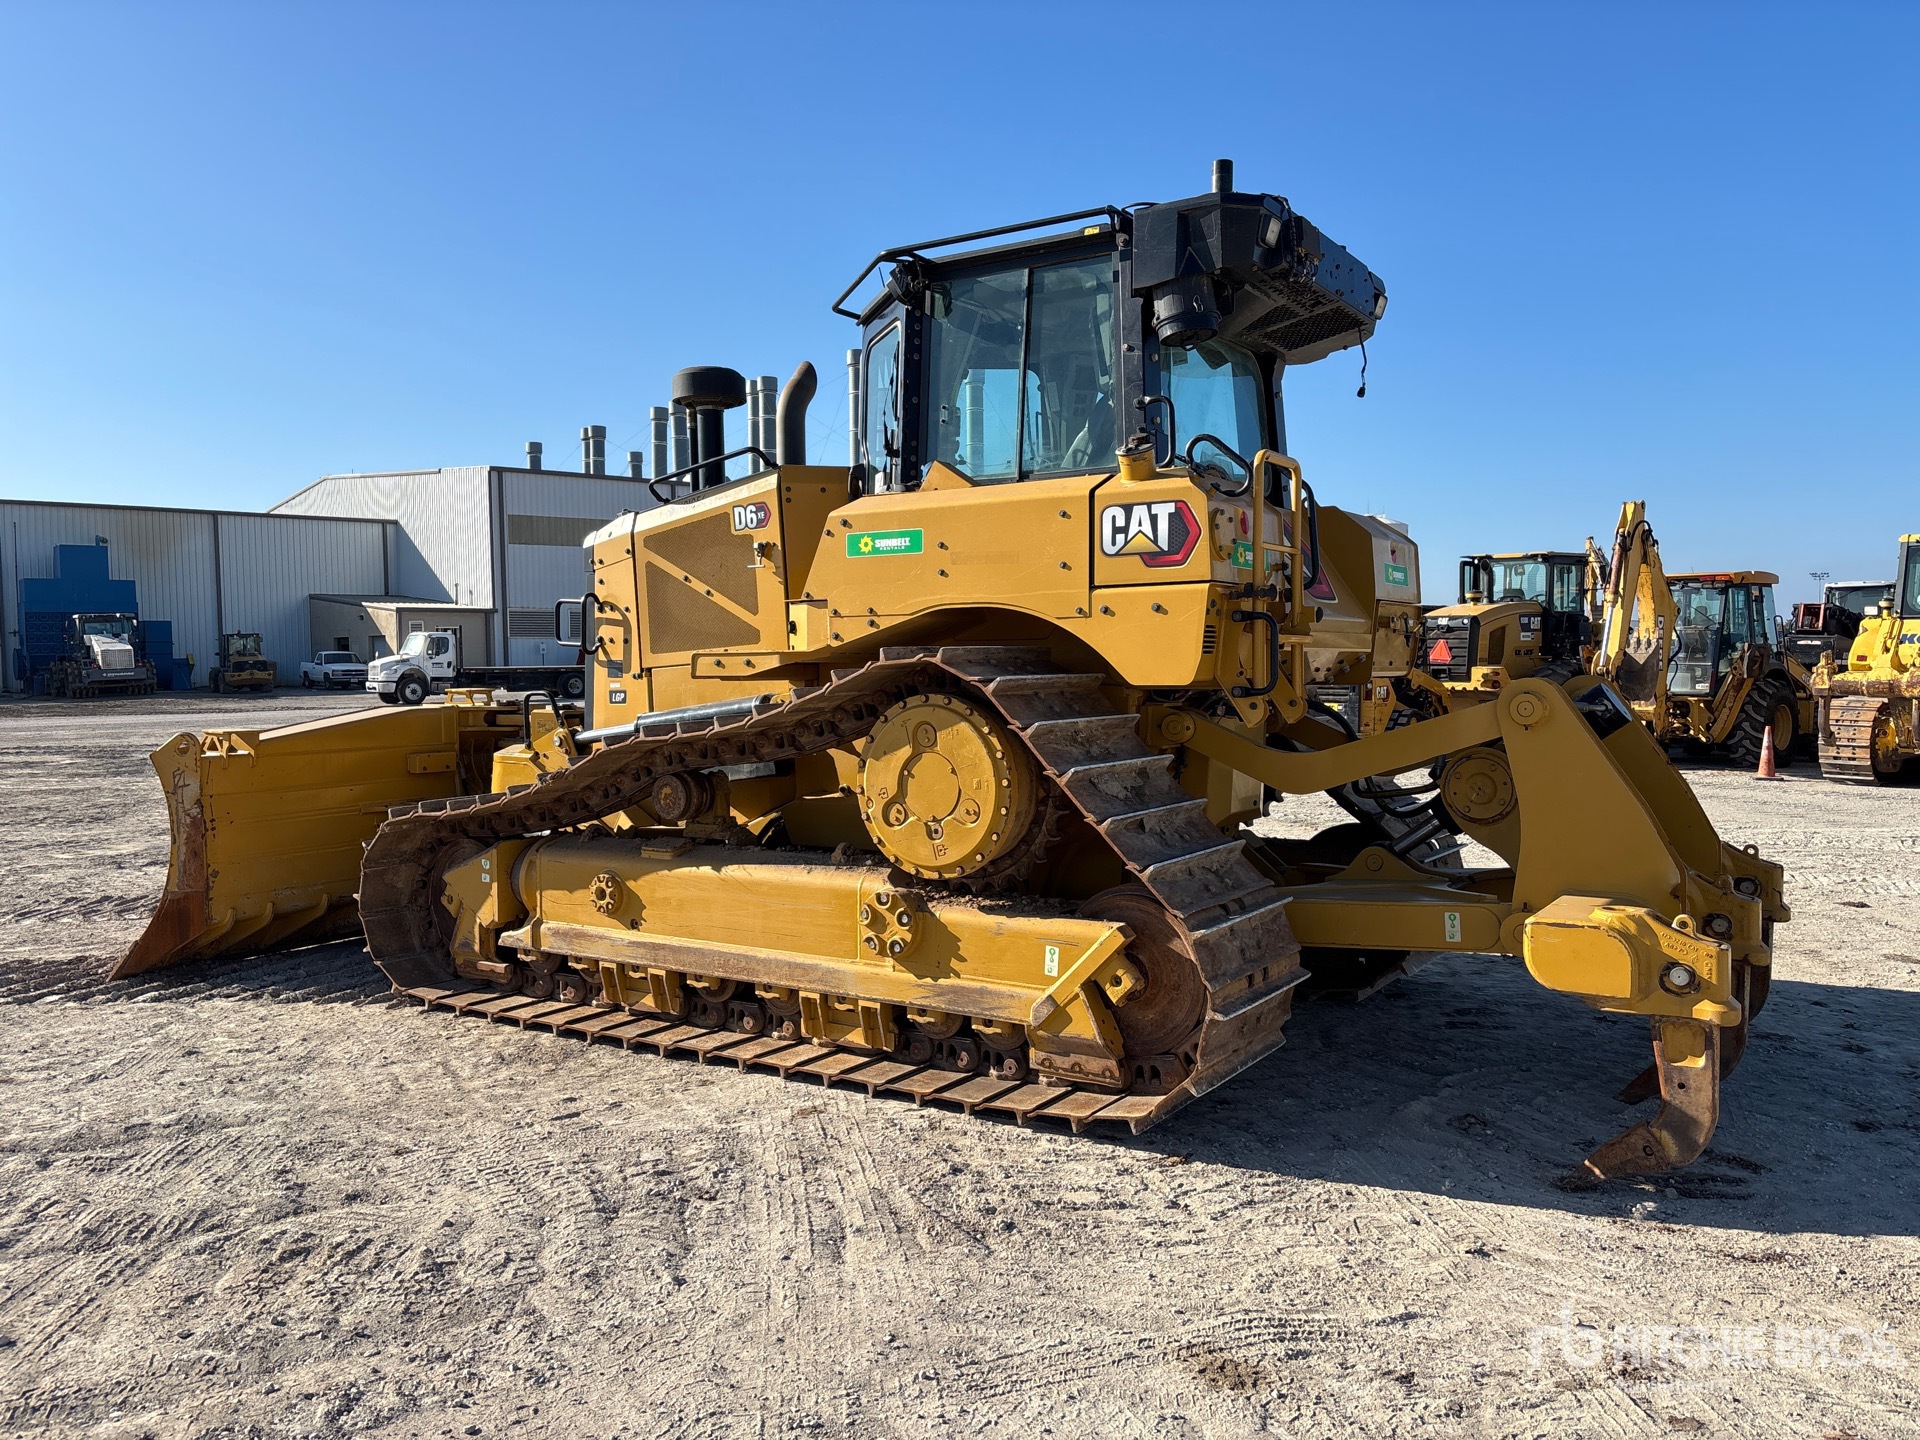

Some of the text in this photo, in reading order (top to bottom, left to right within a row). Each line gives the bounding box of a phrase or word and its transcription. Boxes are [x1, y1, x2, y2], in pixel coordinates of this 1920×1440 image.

[733, 504, 757, 531] D6
[1102, 502, 1175, 555] CAT
[875, 537, 911, 548] SUNBELT
[1437, 617, 1450, 625] CAT
[1530, 616, 1541, 630] CAT
[612, 692, 625, 702] LGP
[1376, 686, 1388, 699] CAT
